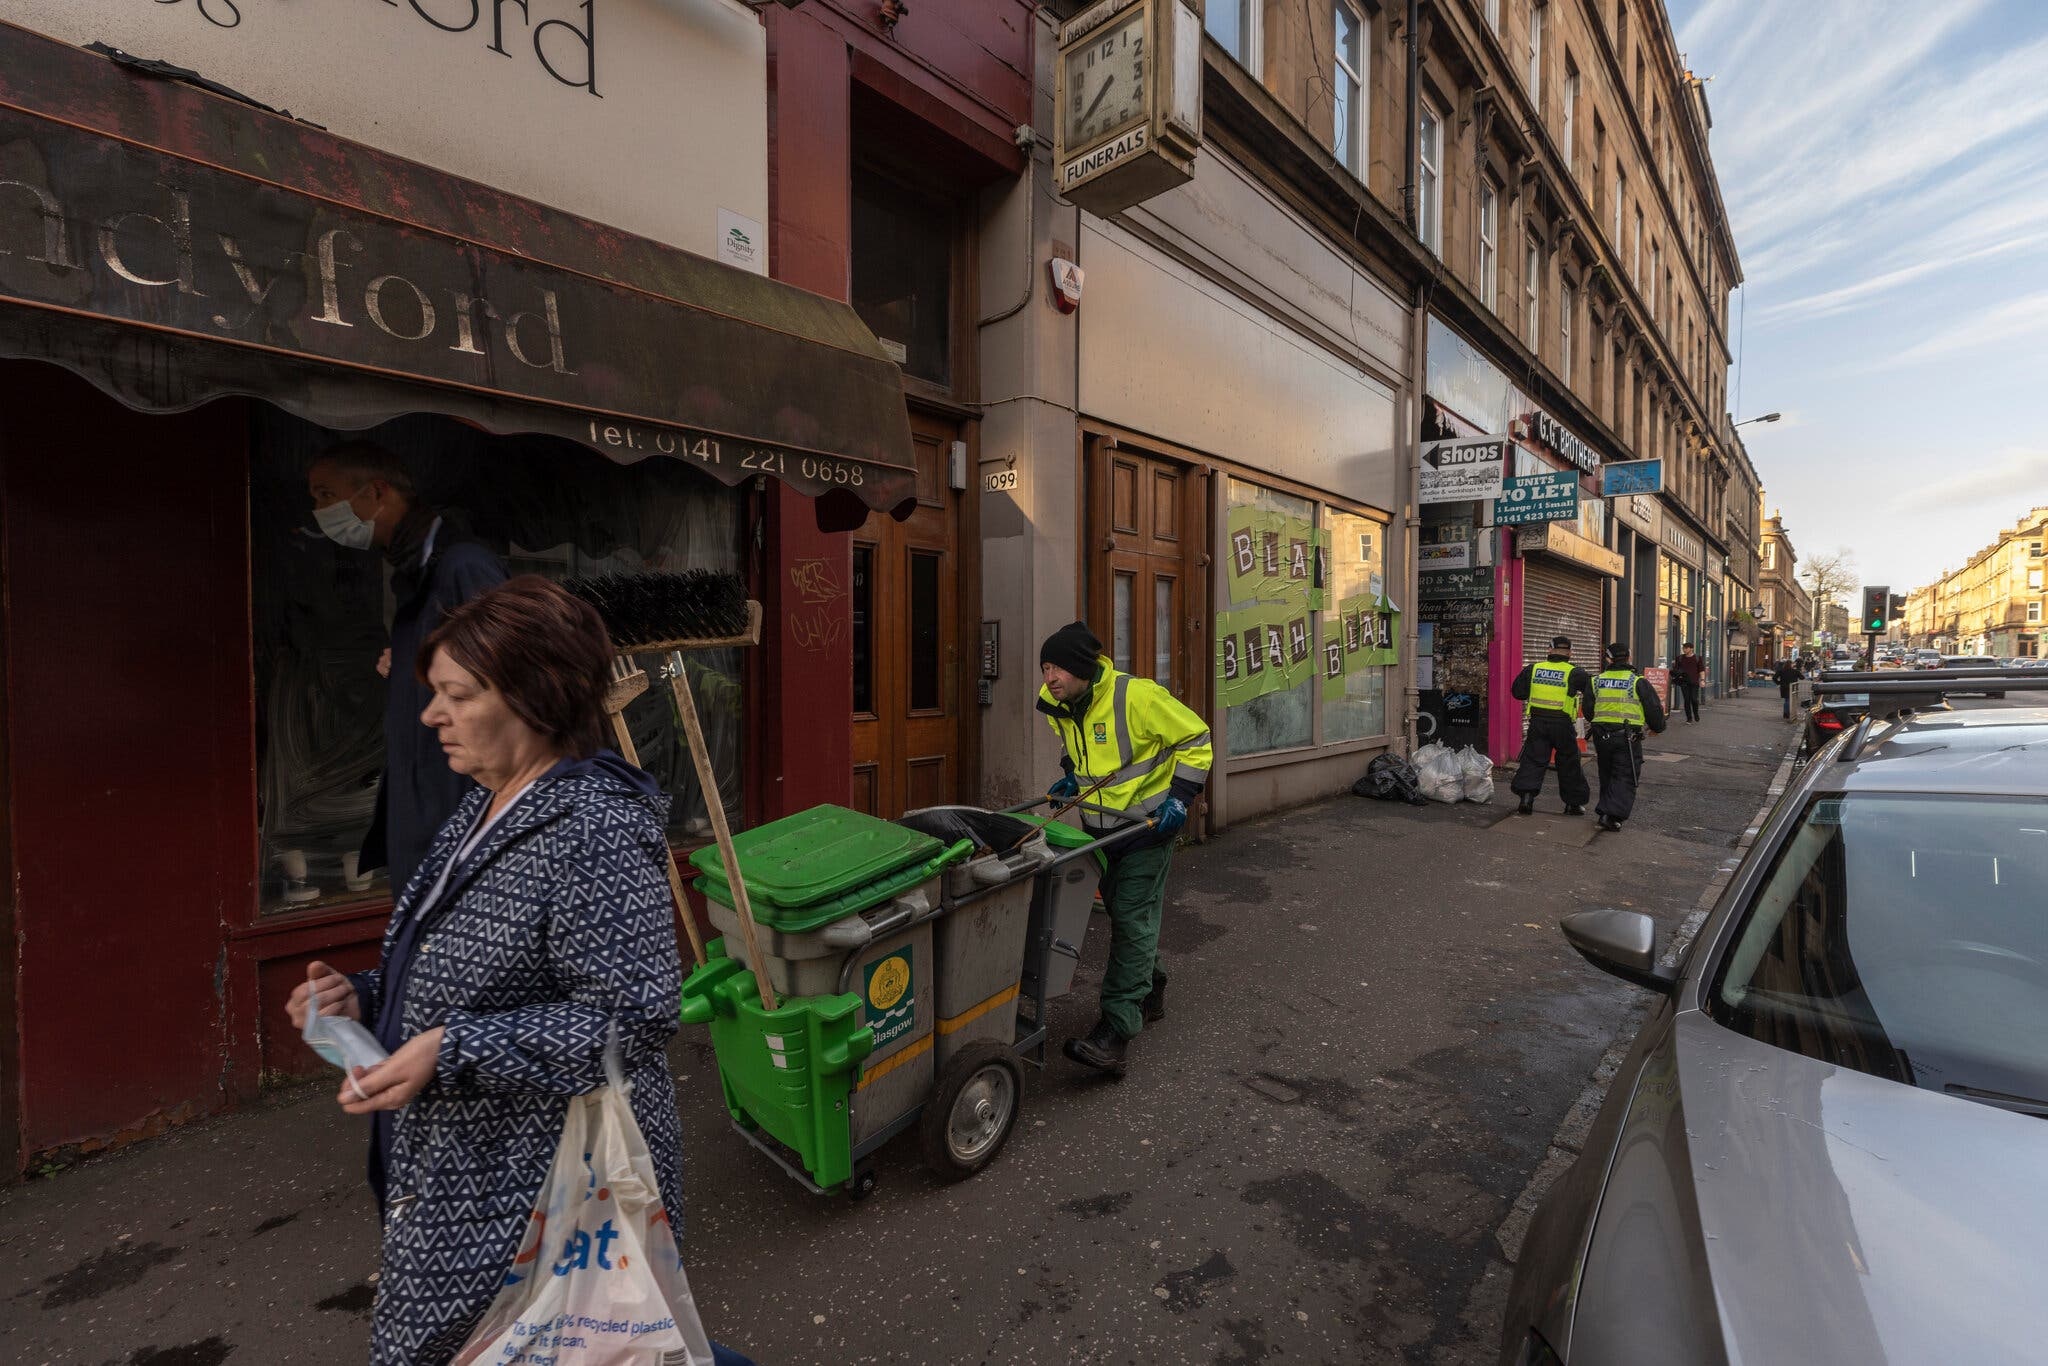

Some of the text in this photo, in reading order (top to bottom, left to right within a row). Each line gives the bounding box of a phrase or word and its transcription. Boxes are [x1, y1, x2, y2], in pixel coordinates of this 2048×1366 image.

[1067, 131, 1144, 182] FUNERALS
[727, 237, 756, 257] Dignity
[656, 430, 720, 464] 0141
[741, 449, 785, 474] 221
[802, 457, 864, 487] 0658
[1441, 443, 1499, 465] shops
[1560, 428, 1595, 475] BROTHERS
[987, 472, 1016, 490] 1099
[1516, 475, 1555, 488] UNITS
[1500, 482, 1575, 503] TO LET
[1497, 509, 1574, 523] 0141 423 9237
[1504, 504, 1532, 512] Large
[1546, 500, 1574, 508] Small
[1536, 670, 1564, 681] POLICE
[1599, 679, 1629, 688] POLICE
[577, 1316, 628, 1334] recycled
[630, 1317, 676, 1336] plastic
